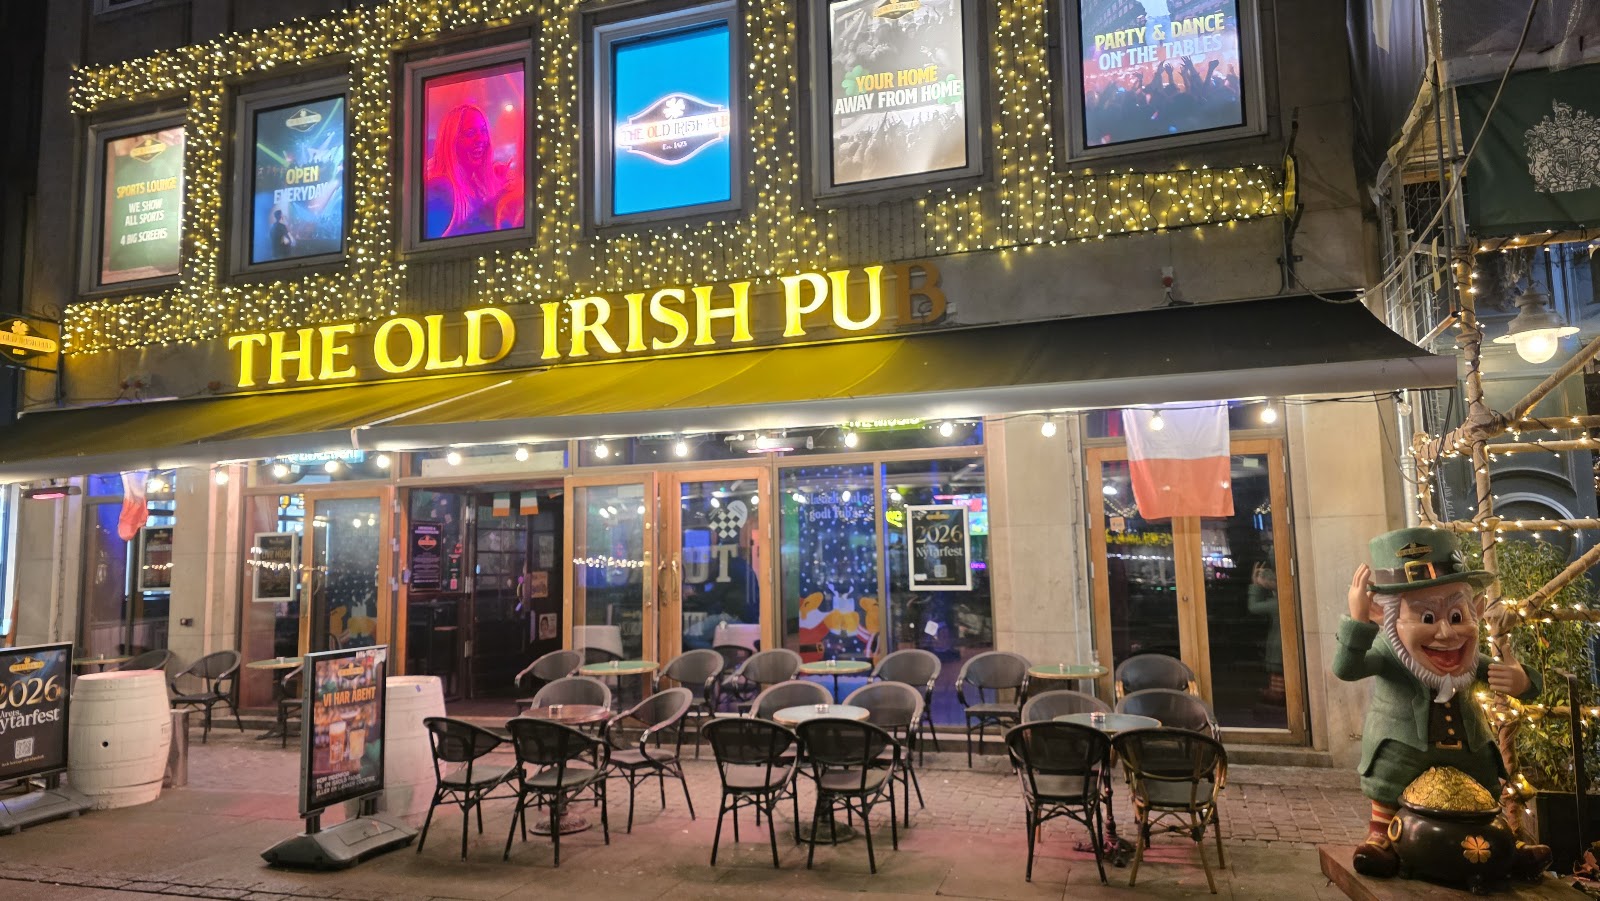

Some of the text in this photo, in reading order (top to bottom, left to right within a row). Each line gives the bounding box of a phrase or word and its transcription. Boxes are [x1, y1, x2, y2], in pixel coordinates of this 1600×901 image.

[1094, 13, 1225, 51] PARTY & DANCE
[1099, 34, 1223, 71] ON THE TABLES
[855, 65, 938, 93] YOUR HOME
[834, 80, 961, 115] AWAY FROM HOME
[647, 124, 671, 138] OLD
[286, 165, 319, 185] OPEN
[116, 176, 177, 199] SPORTS LOUNGE
[273, 182, 329, 204] EVERYDAY
[128, 198, 164, 214] WE SHOW
[124, 210, 165, 227] ALL SPORTS
[120, 235, 126, 246] 4
[138, 227, 168, 243] SCREENS
[228, 262, 948, 388] THE OLD IRISH PUB
[915, 525, 963, 543] 2026
[323, 693, 333, 708] VI
[333, 690, 351, 705] HAR
